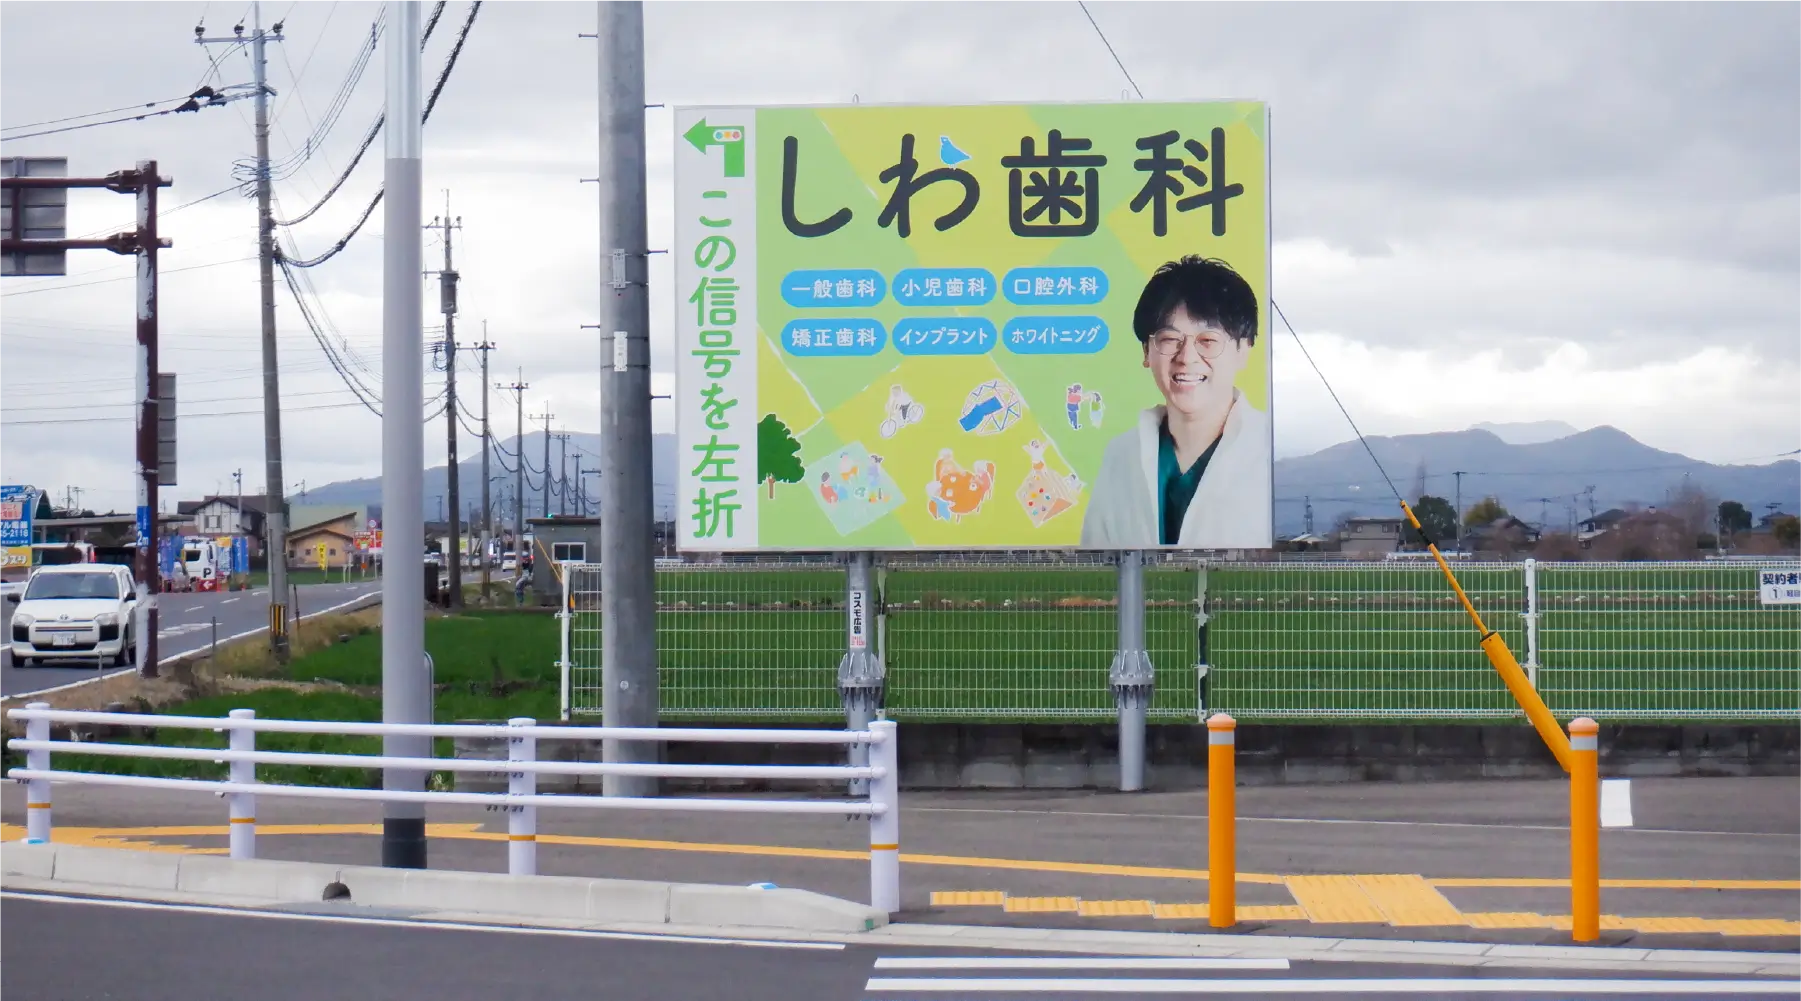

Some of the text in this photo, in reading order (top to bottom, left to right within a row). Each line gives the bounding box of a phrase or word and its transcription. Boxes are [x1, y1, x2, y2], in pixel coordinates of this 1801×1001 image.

[781, 127, 1244, 238] しわ歯科
[791, 278, 877, 298] 一般歯科
[901, 278, 987, 297] 小児歯科
[1014, 276, 1099, 296] 口腔外科
[791, 327, 877, 347] 矯正歯科
[900, 327, 988, 345] インプラント
[1011, 325, 1101, 344] ホワイトニング
[689, 191, 740, 538] この信号を左折
[203, 568, 212, 578] P
[1762, 572, 1801, 585] 契約者
[853, 592, 862, 635] コスモ広告
